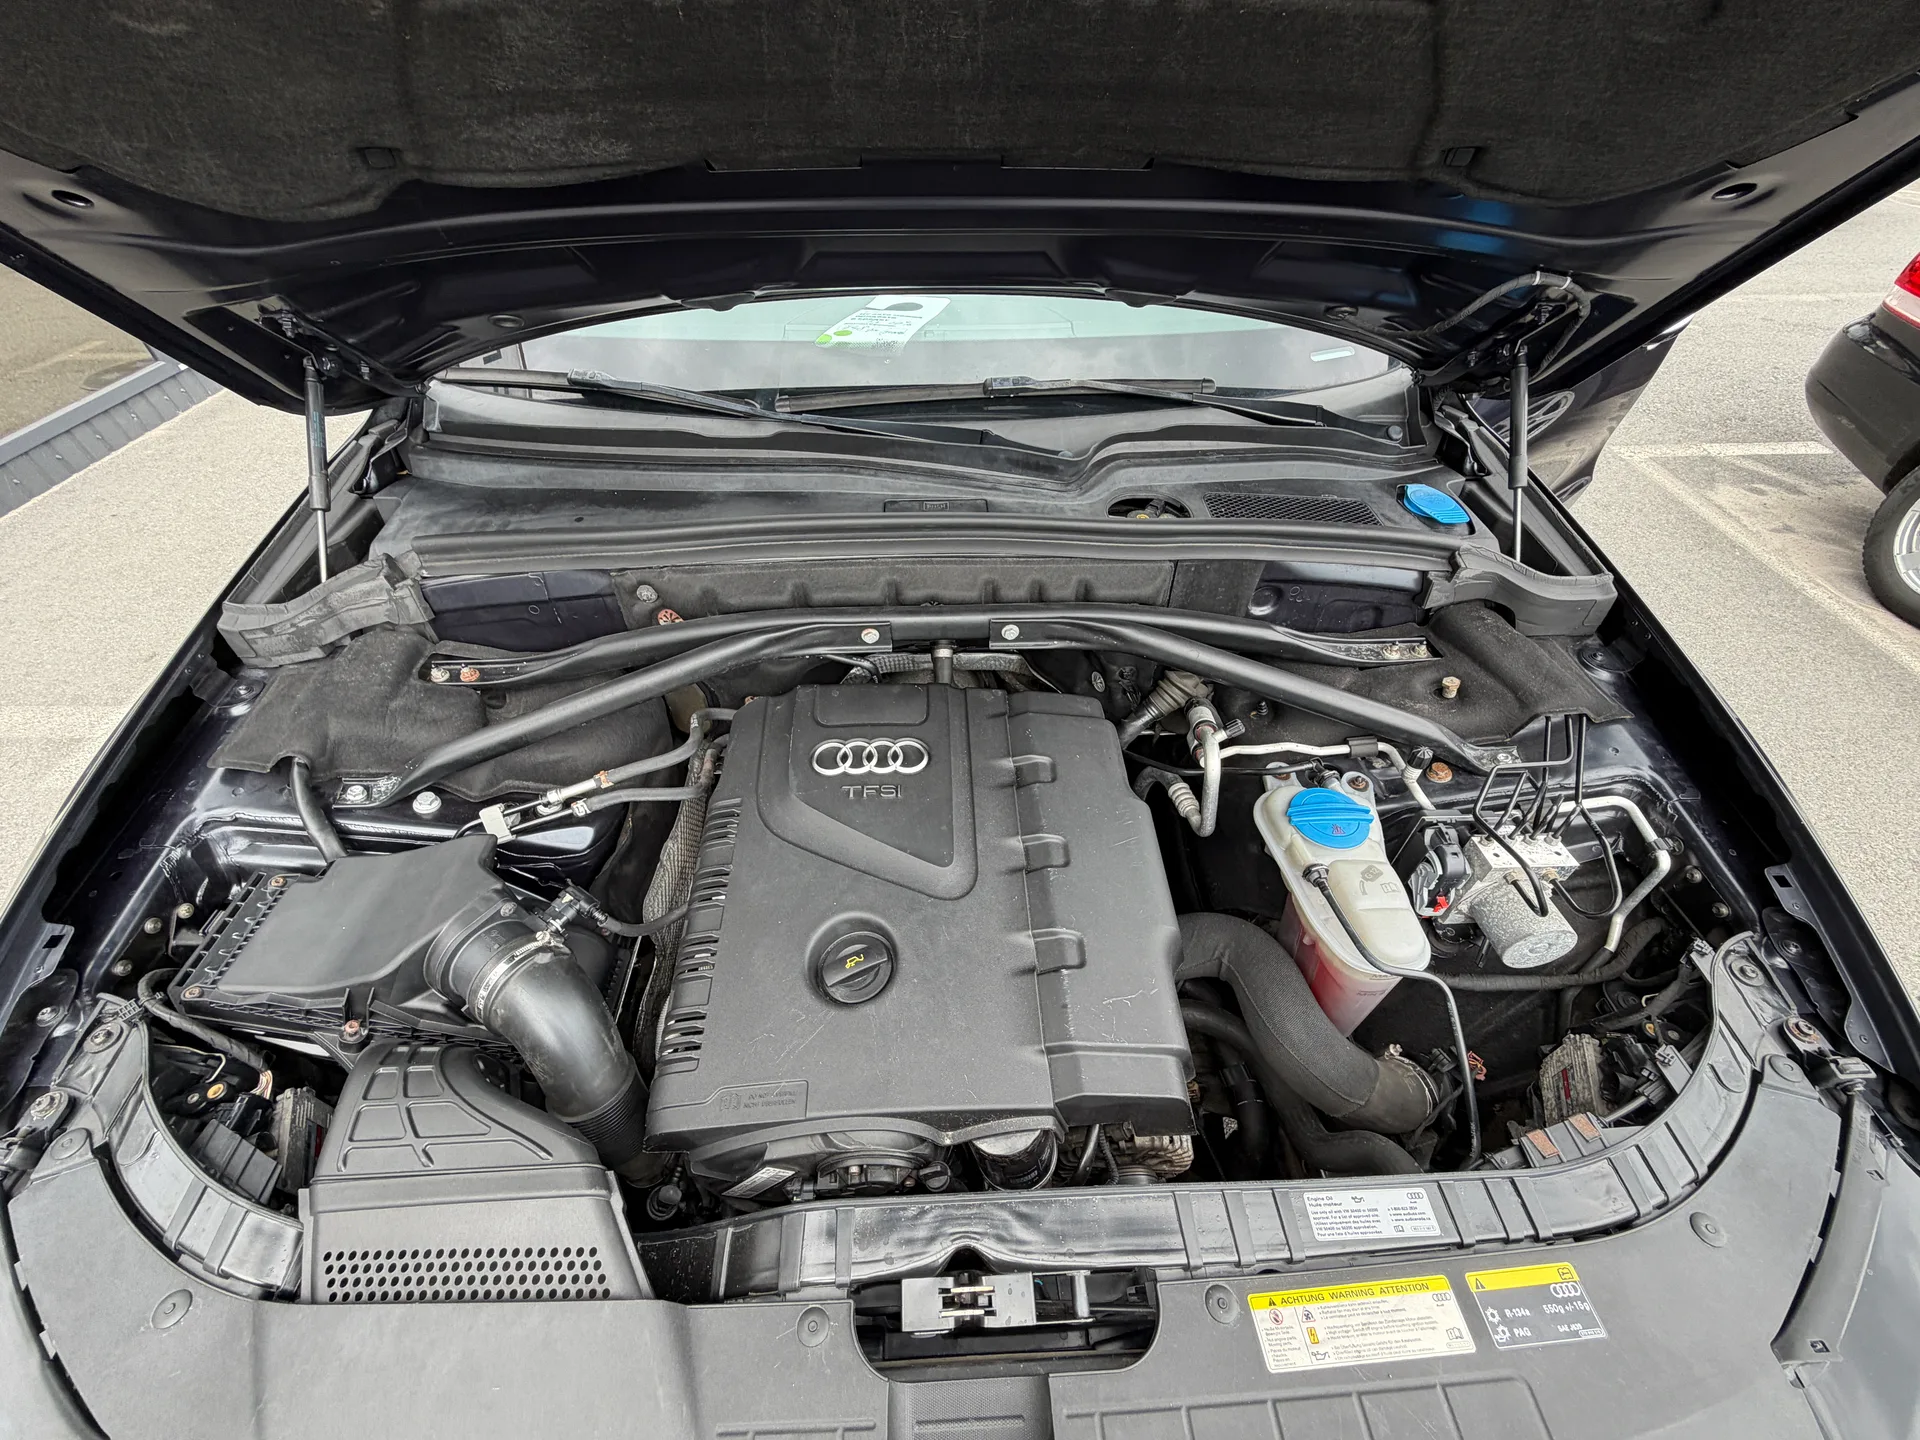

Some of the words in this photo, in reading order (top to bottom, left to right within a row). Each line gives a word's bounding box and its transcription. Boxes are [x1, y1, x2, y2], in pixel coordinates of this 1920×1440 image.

[841, 784, 902, 799] TFSI
[1364, 867, 1380, 879] G12
[1279, 1292, 1325, 1305] ACHTUNG
[1328, 1287, 1375, 1300] WARNING
[1378, 1282, 1429, 1294] ATTENTION
[1504, 1307, 1531, 1318] R-134a
[1542, 1303, 1566, 1314] 550g
[1513, 1327, 1532, 1338] PAG
